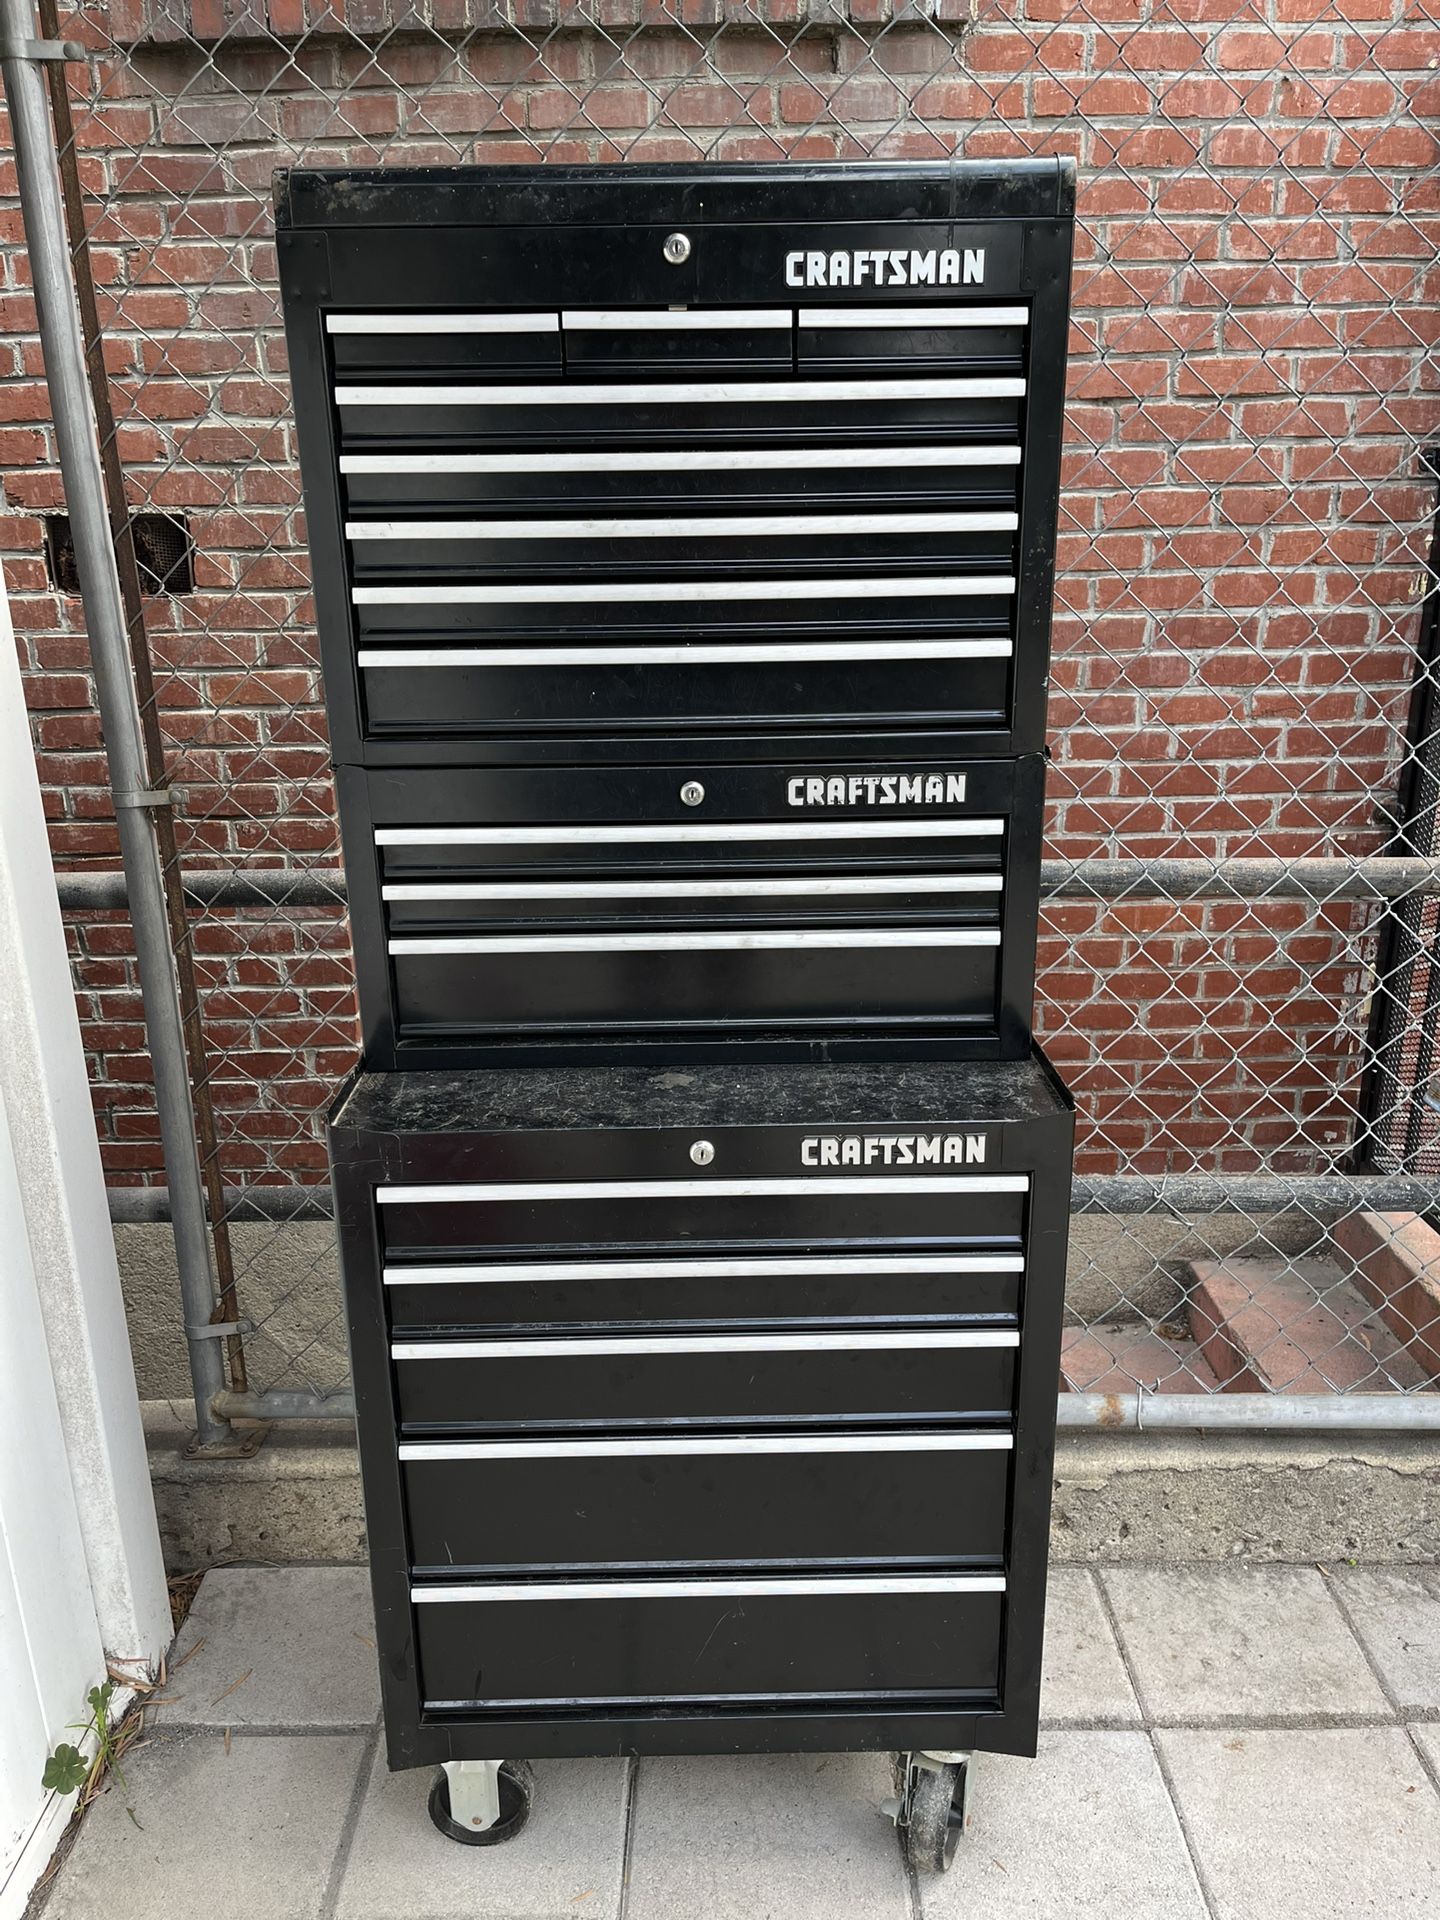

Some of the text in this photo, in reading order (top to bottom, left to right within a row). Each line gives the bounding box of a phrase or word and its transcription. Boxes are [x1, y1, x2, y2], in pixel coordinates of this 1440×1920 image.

[785, 249, 986, 287] CRAFTSMAN
[787, 774, 967, 806] CRAFTSMAN
[801, 1134, 986, 1166] CRAFTSMAN
